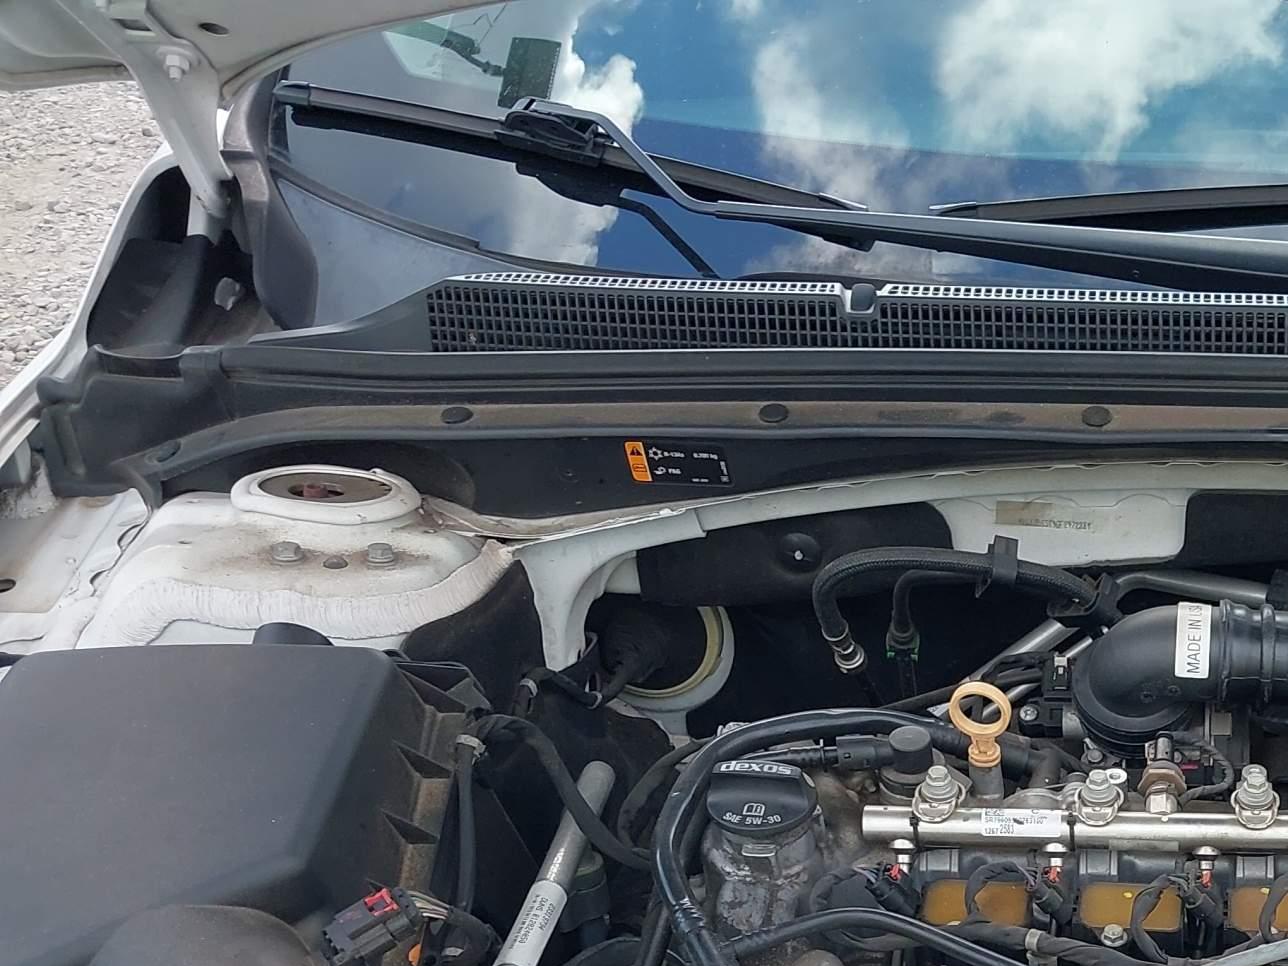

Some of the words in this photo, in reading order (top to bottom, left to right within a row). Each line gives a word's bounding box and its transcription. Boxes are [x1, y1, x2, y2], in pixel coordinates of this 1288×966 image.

[1187, 619, 1203, 630] IN
[1186, 634, 1202, 674] MADE
[720, 761, 792, 775] dexos
[722, 812, 743, 824] SAE
[744, 814, 782, 825] 5W-30
